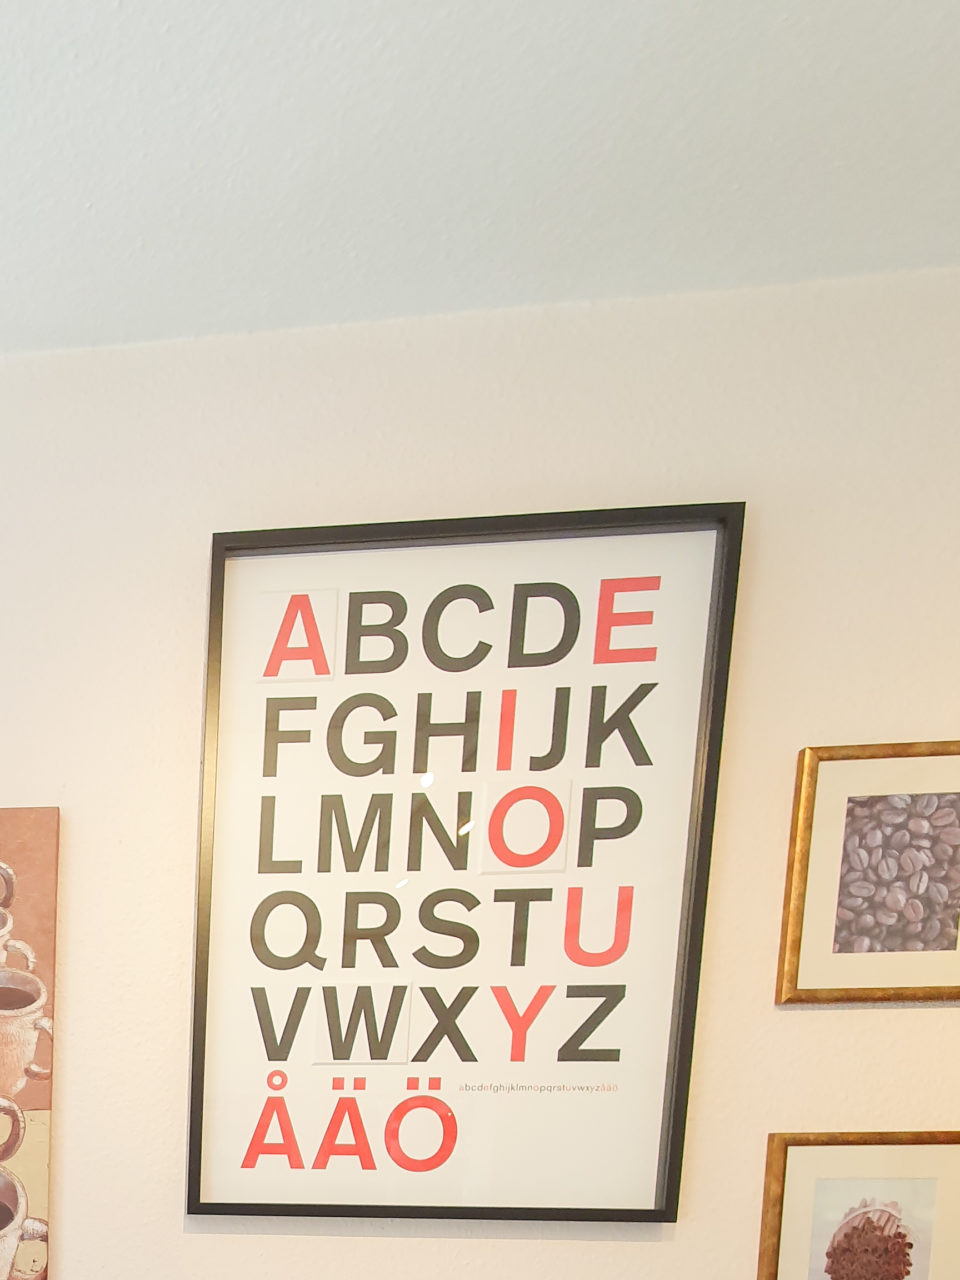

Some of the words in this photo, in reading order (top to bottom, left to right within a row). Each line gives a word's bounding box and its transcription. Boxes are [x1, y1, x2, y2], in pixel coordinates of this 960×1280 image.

[262, 574, 661, 678] ABCDE
[262, 682, 660, 777] FGHIJK
[257, 785, 644, 875] LMNOP
[249, 885, 634, 972] QRSTU
[250, 983, 627, 1062] VWXYZ
